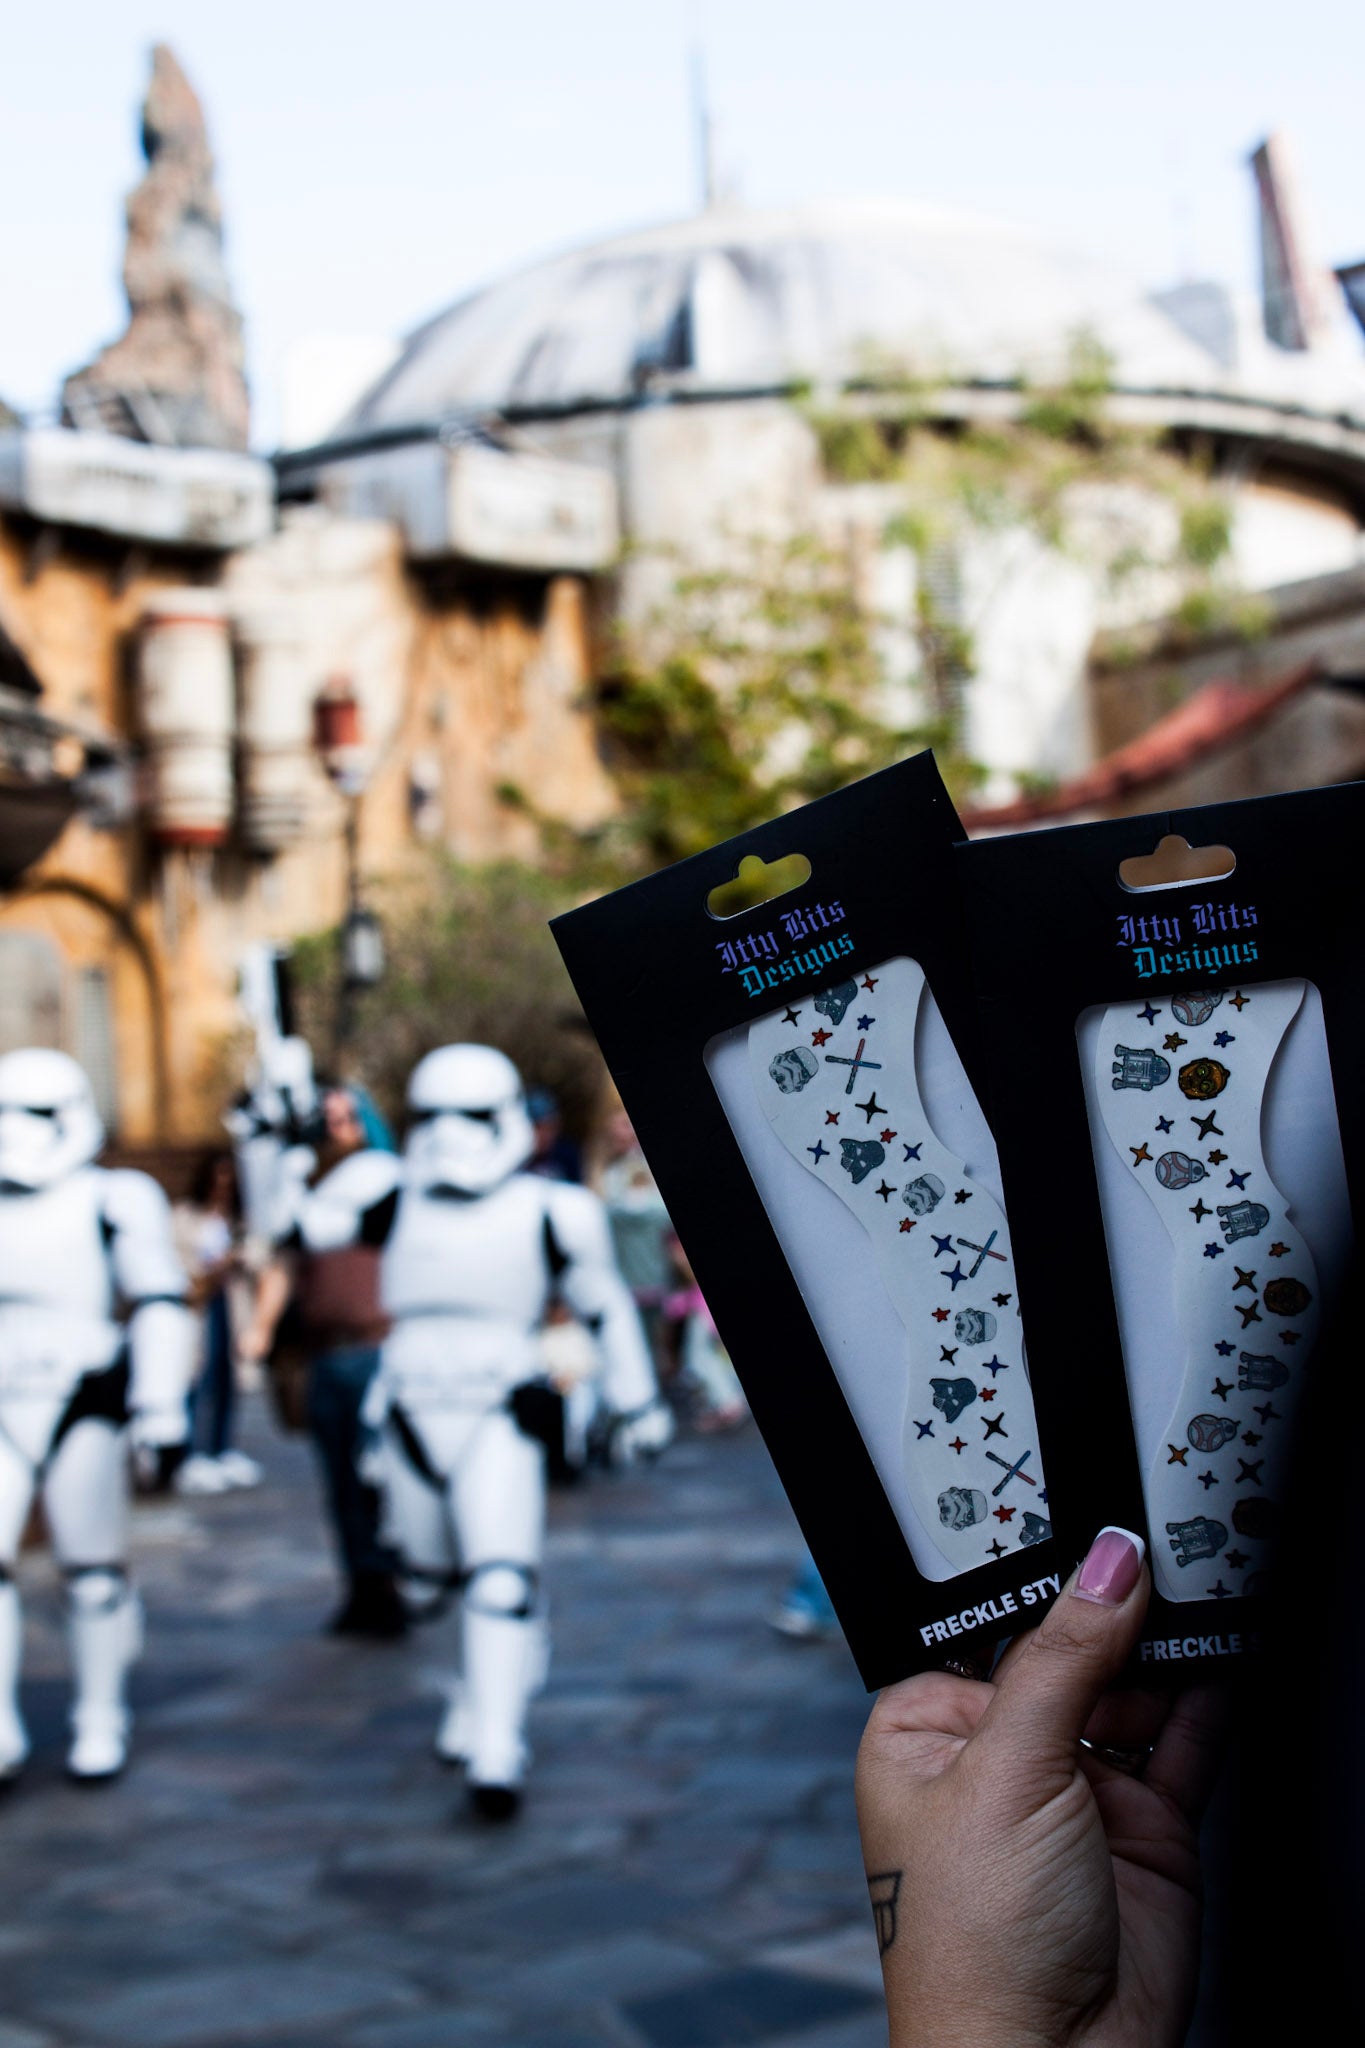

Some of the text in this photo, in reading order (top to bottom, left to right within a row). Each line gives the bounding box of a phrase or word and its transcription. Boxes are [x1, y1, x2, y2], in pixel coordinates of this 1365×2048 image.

[715, 900, 846, 974] Itty Bits
[1115, 902, 1258, 947] Itty Bits
[737, 933, 855, 998] Designs
[1131, 941, 1258, 979] Designs
[919, 1572, 1061, 1647] FRECKLE STY
[1139, 1633, 1243, 1662] FRECKLE
